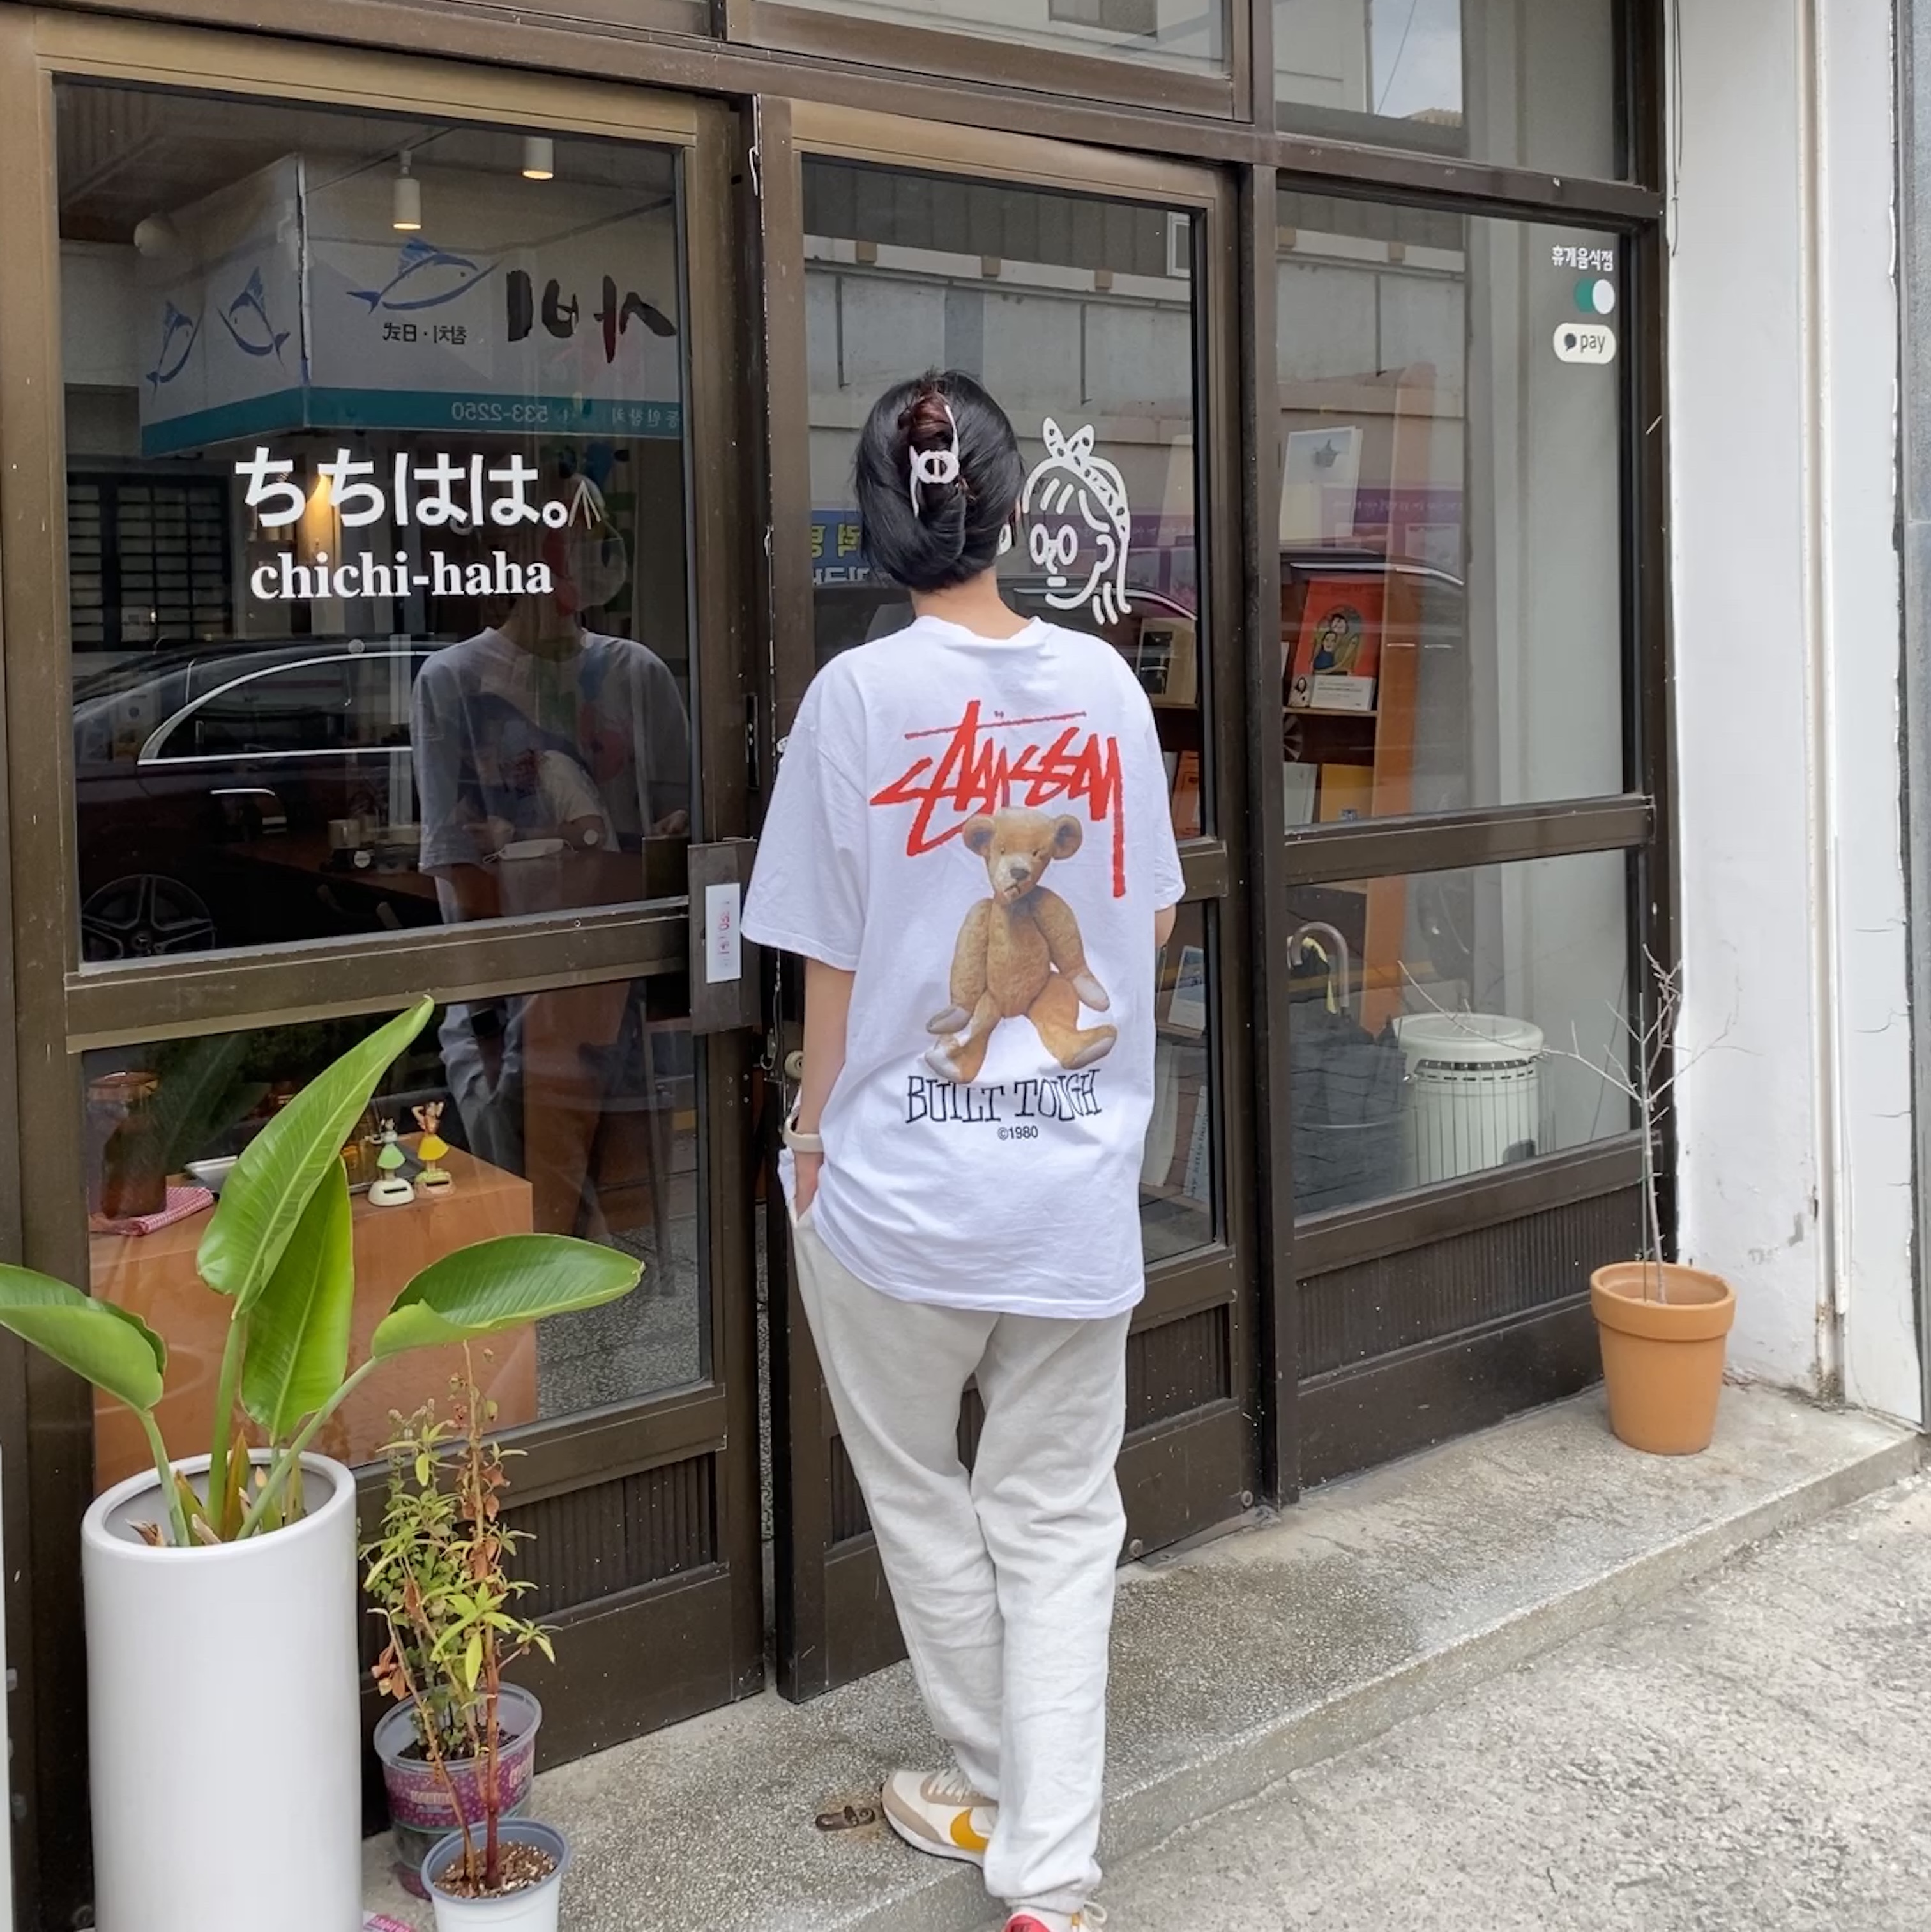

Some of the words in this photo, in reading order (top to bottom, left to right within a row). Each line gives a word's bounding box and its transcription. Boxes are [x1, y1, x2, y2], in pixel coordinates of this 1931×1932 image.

[1552, 245, 1614, 272] 휴게음식점
[1580, 333, 1605, 354] pay
[234, 446, 568, 529] ちちはは。
[250, 551, 554, 600] chichi-haha
[905, 1076, 1004, 1124] BUILT
[1013, 1069, 1102, 1122] TOUGH
[997, 1125, 1039, 1141] ©1980
